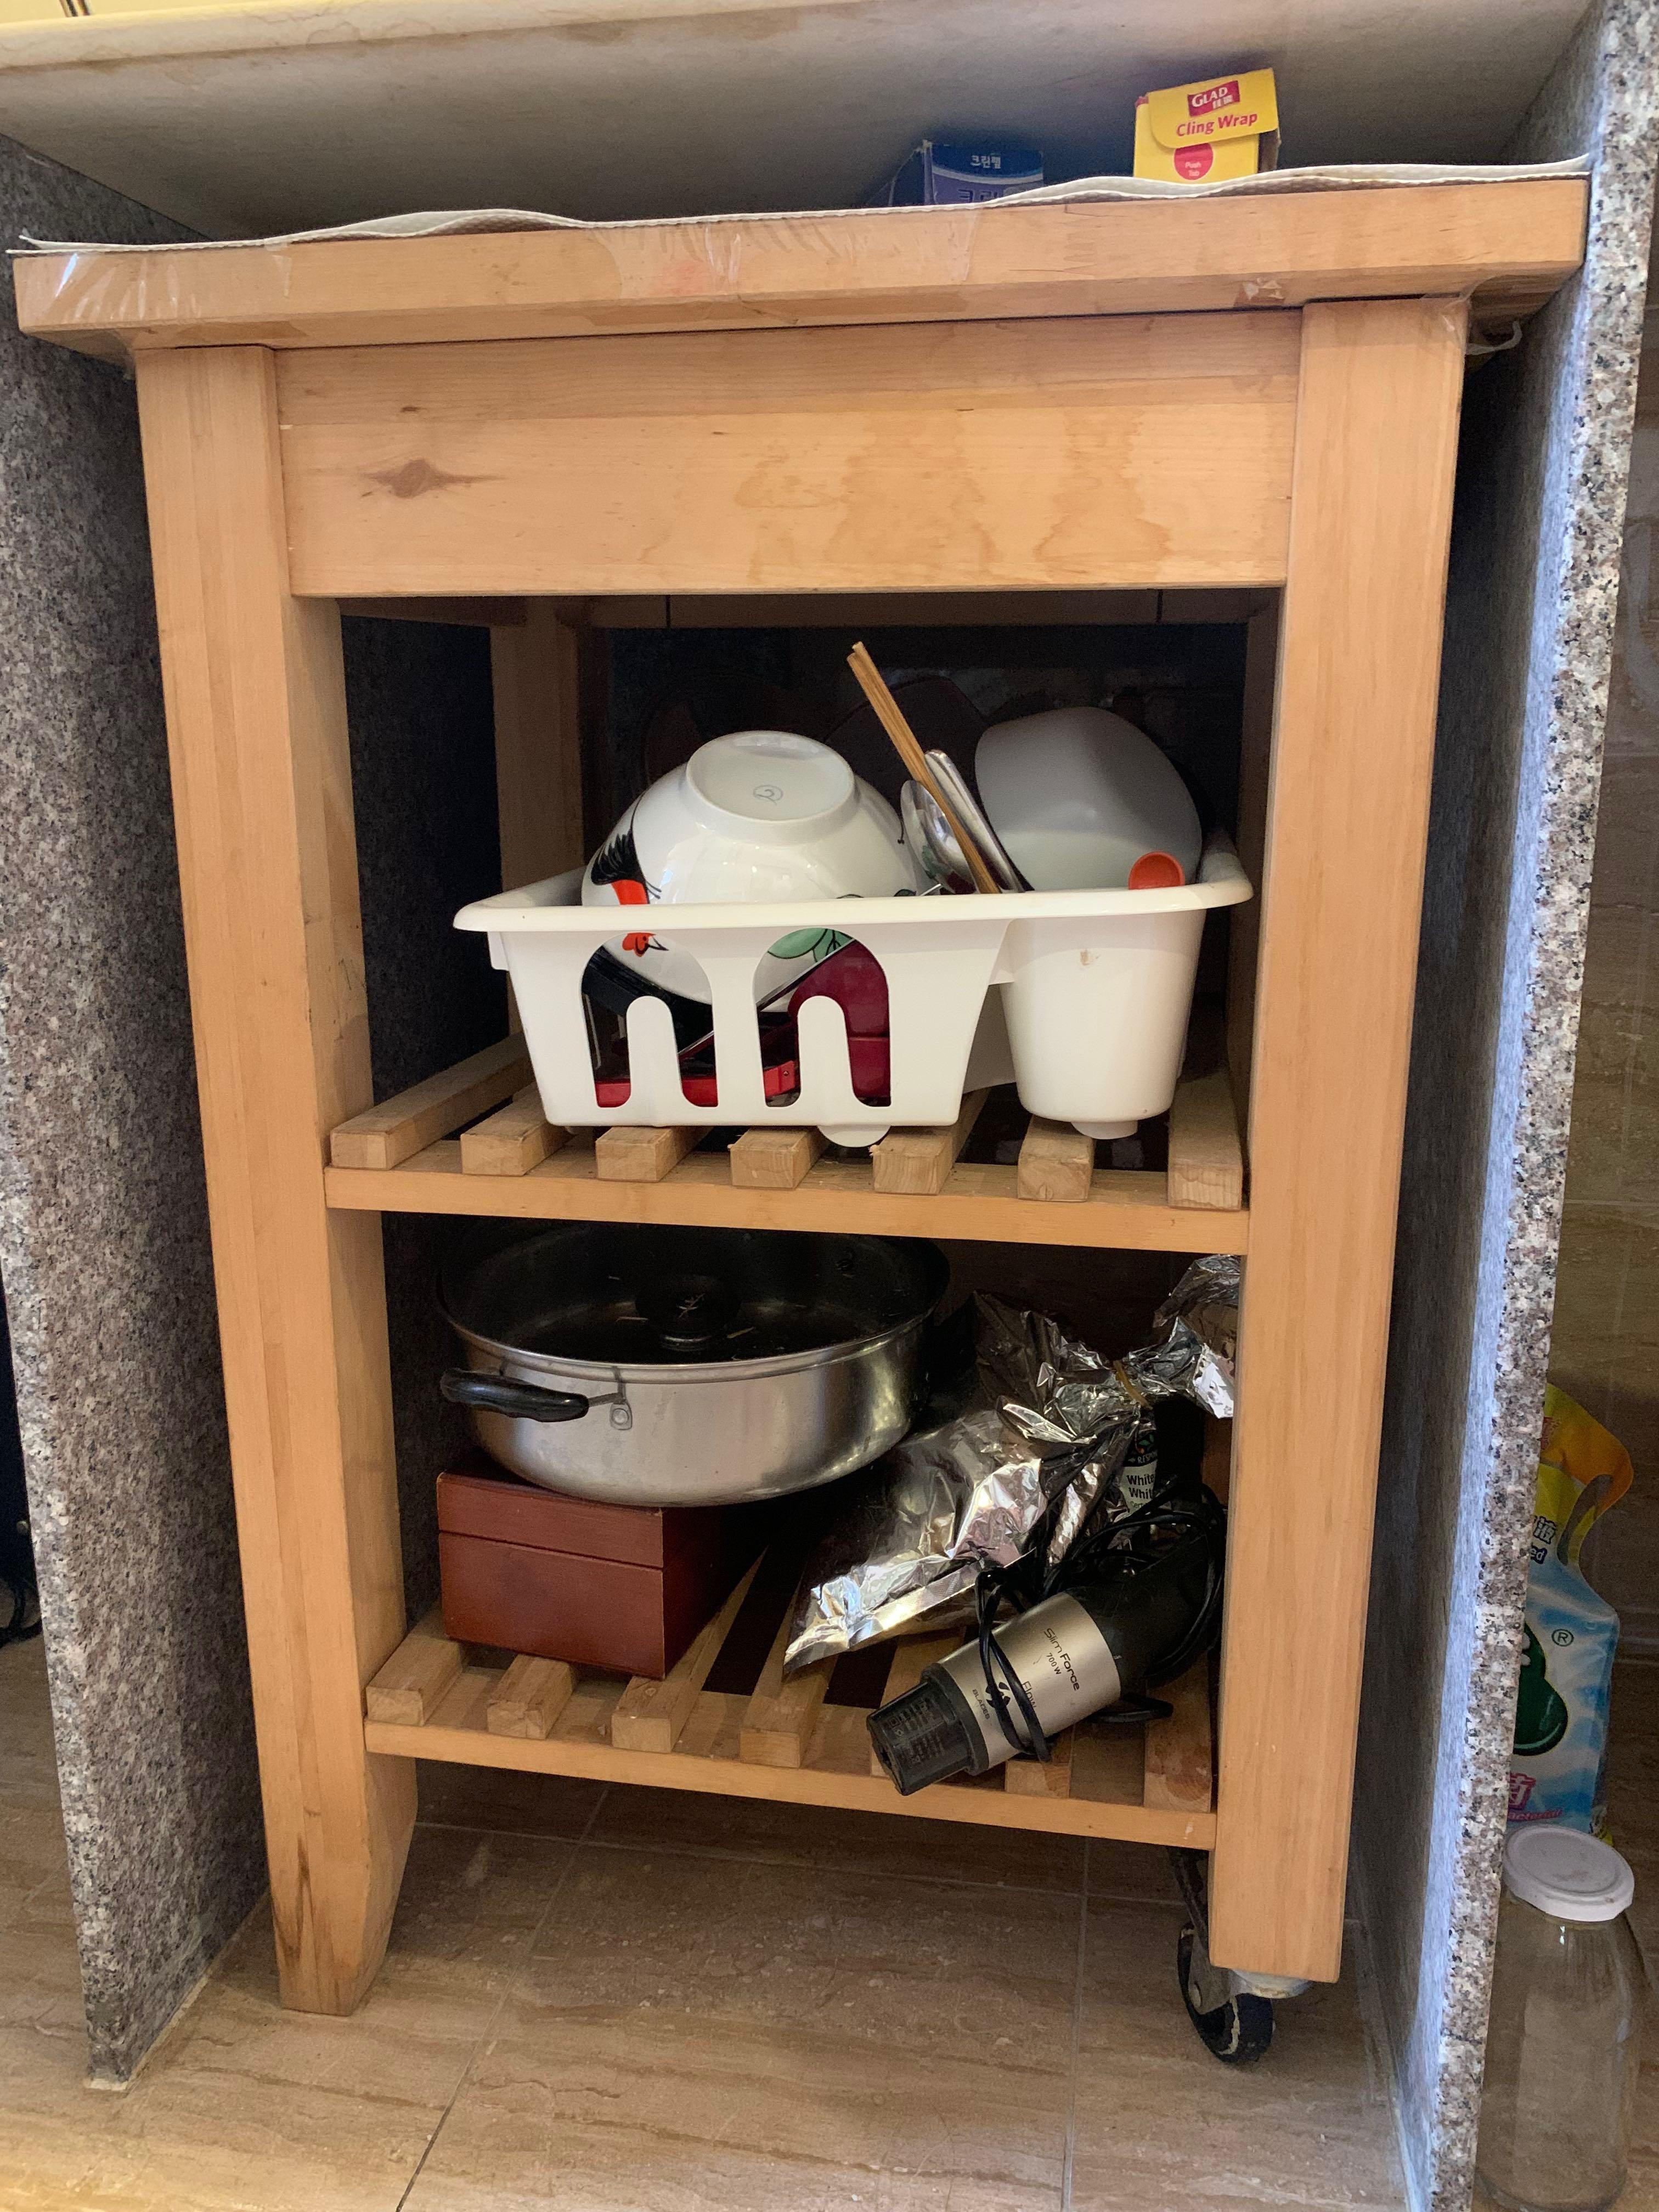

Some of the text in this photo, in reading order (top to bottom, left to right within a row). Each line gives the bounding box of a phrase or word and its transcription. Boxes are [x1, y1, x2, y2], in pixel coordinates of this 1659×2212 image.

[1192, 87, 1228, 107] GLAD
[1176, 114, 1257, 136] Cling Wrap
[1126, 1474, 1154, 1486] White
[1128, 1487, 1152, 1499] Whit
[1043, 1628, 1080, 1691] Slim Force
[972, 1689, 990, 1720] BLADES
